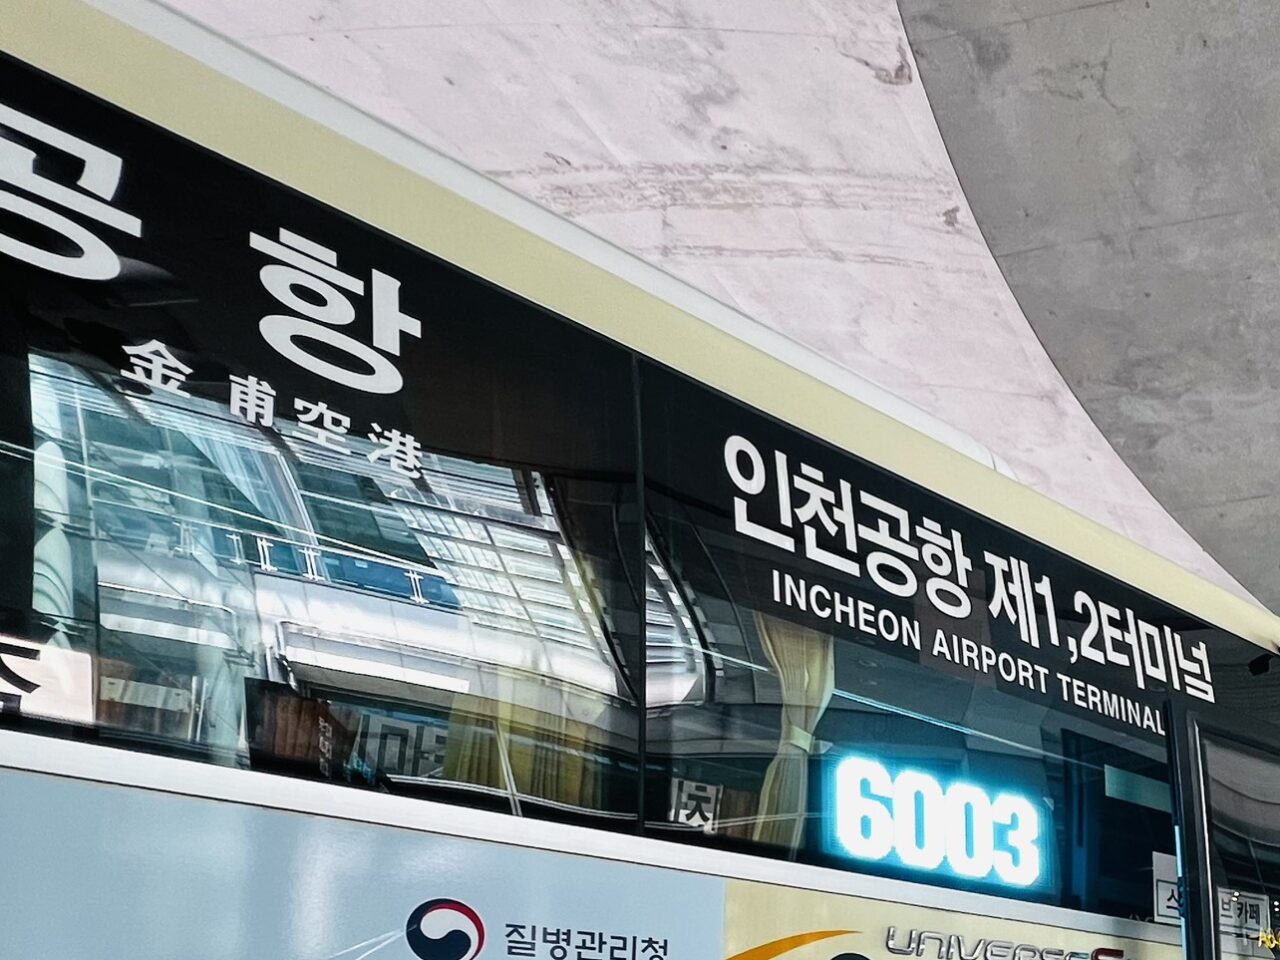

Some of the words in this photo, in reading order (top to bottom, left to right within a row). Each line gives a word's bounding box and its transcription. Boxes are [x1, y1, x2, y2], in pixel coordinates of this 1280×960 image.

[724, 435, 972, 619] 인천공항
[984, 551, 1215, 703] 제1,2터미널
[772, 569, 921, 650] INCHEON
[932, 629, 1049, 694] AIRPORT
[1056, 672, 1166, 736] TERMINAL
[836, 756, 1041, 887] 6003
